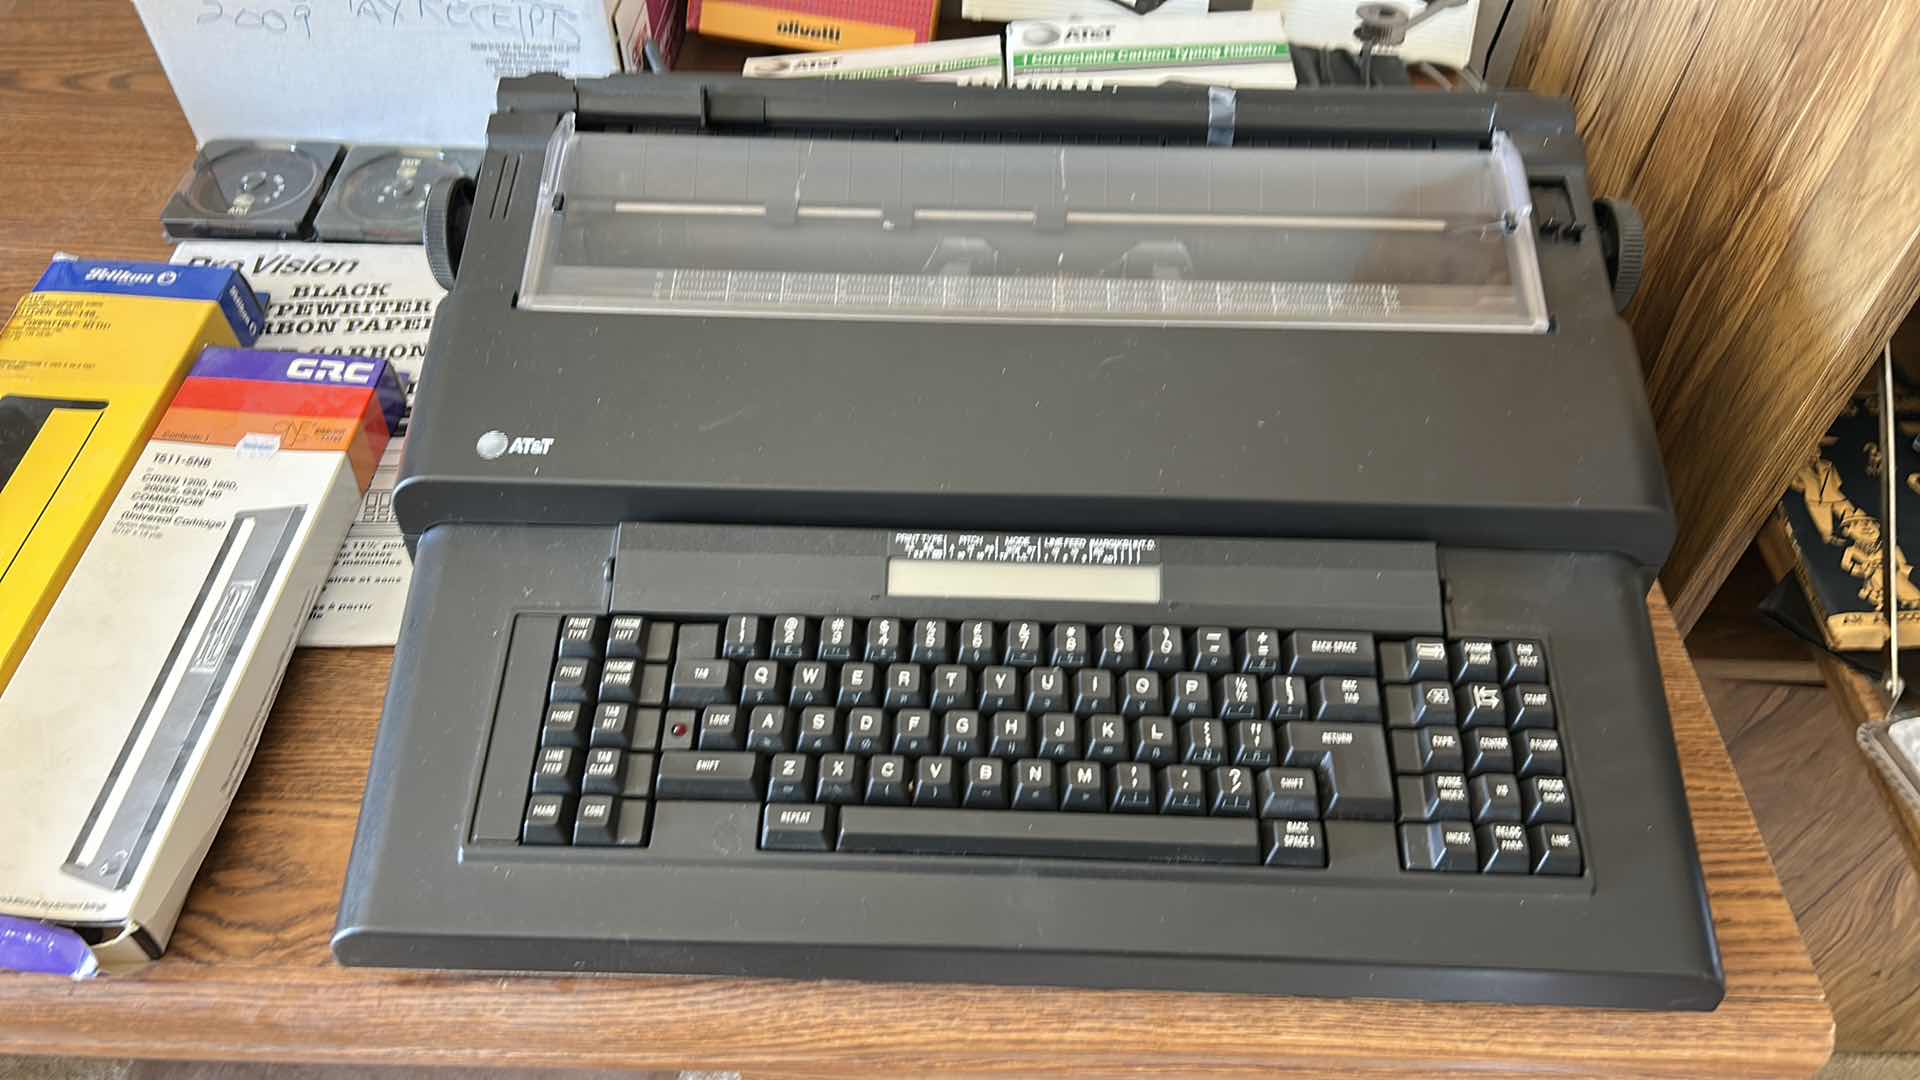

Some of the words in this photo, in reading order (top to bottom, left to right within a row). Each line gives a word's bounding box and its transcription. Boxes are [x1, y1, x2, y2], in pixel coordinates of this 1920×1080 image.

[1064, 25, 1114, 42] AT&T
[1031, 52, 1116, 66] Correctable
[1117, 49, 1171, 62] Carbon
[1175, 47, 1222, 62] Typing
[1223, 44, 1278, 58] Ribbon
[252, 253, 360, 277] Vision
[85, 266, 154, 287] Pelikan
[291, 281, 392, 299] BLACK
[266, 300, 433, 318] YPEWRITER
[261, 317, 338, 336] RBON
[286, 357, 376, 385] GRC
[507, 436, 555, 456] AT&T
[131, 491, 206, 507] COMMODORE
[895, 532, 920, 545] PRINT
[921, 533, 944, 545] TYPE
[959, 534, 984, 546] PITCH
[1064, 537, 1087, 549] FEED
[566, 617, 592, 629] PRINT
[613, 618, 641, 629] MARGIN
[831, 616, 846, 631] #
[879, 619, 890, 634] $
[567, 629, 589, 641] TYPE
[614, 630, 634, 641] LEFT
[783, 630, 796, 644] 2
[1066, 637, 1077, 652] 8
[559, 666, 583, 677] PITCH
[606, 661, 634, 673] MARGIN
[694, 667, 709, 679] TAB
[754, 666, 769, 684] Q
[802, 667, 820, 684] W
[851, 669, 864, 685] E
[898, 670, 911, 686] R
[945, 672, 958, 688] T
[995, 673, 1007, 689] Y
[1041, 674, 1054, 690] U
[1092, 676, 1098, 692] I
[1135, 677, 1150, 694] O
[1185, 679, 1199, 695] P
[1343, 692, 1361, 704] TAB
[550, 710, 574, 722] MODE
[604, 705, 620, 717] TAB
[709, 714, 731, 725] LOCK
[761, 713, 774, 729] A
[812, 713, 825, 730] S
[860, 715, 873, 730] D
[908, 716, 921, 731] F
[955, 717, 969, 733] G
[1005, 719, 1018, 735] H
[1055, 720, 1065, 737] J
[1102, 721, 1115, 738] K
[1151, 723, 1164, 740] L
[1321, 731, 1353, 745] RETURN
[545, 749, 565, 761] LINE
[597, 751, 613, 763] TAB
[542, 762, 563, 774] FEED
[588, 764, 614, 776] CLEAR
[695, 759, 720, 771] SHIFT
[782, 759, 796, 775] Z
[832, 760, 844, 776] X
[881, 762, 895, 777] C
[930, 763, 942, 778] V
[979, 764, 992, 780] B
[1029, 766, 1042, 782] N
[1077, 767, 1092, 784] M
[1280, 777, 1304, 789] SHIFT
[584, 804, 606, 817] CODE
[780, 811, 811, 824] REPEAT
